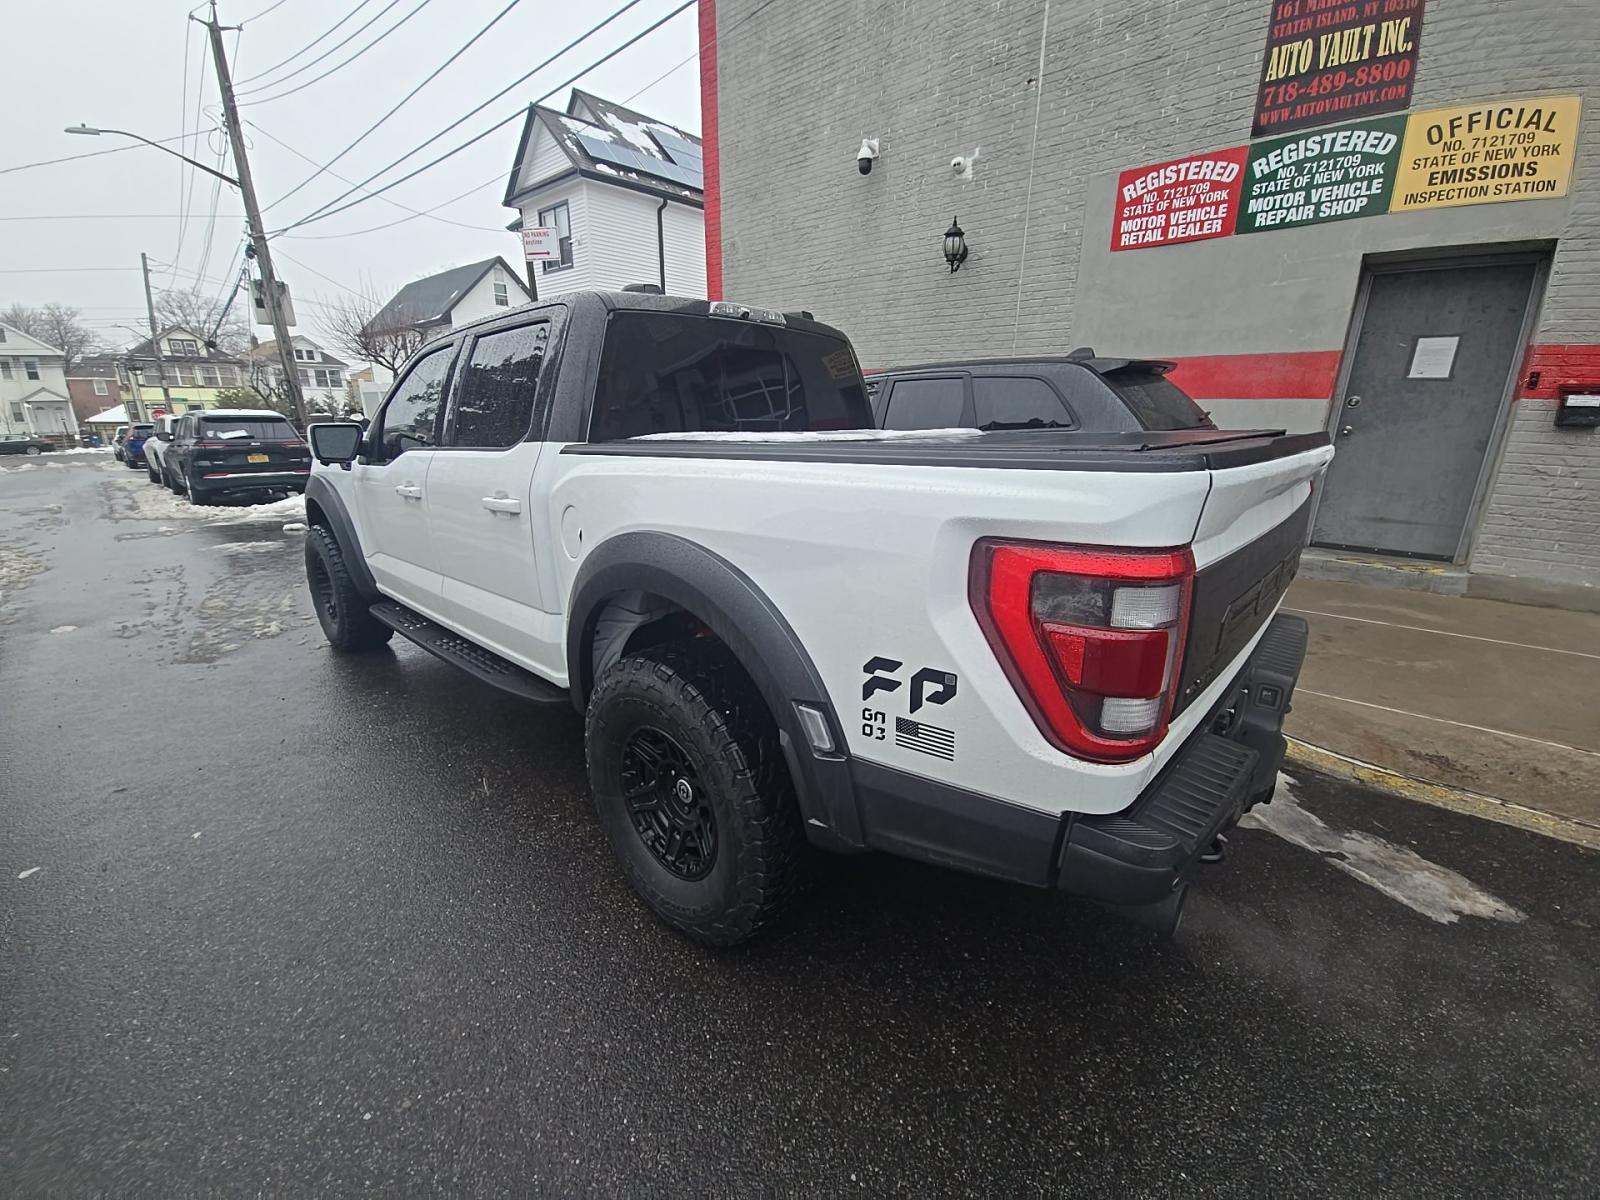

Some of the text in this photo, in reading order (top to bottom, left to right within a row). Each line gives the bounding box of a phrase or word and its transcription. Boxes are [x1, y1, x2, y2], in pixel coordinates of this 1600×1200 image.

[1272, 18, 1312, 39] STATEN
[1316, 6, 1359, 27] ISLAND,
[1363, 2, 1380, 17] NY
[1276, 0, 1299, 20] 161
[1266, 17, 1413, 81] AUTO VAULT INC.
[1264, 58, 1412, 107] 718-489-8800
[1260, 85, 1408, 126] WWW.AUTOVAULTNY.COM
[1427, 107, 1557, 146] OFFICIAL
[1252, 130, 1397, 179] REGISTERED
[1412, 143, 1561, 171] STATE OF NEW YORK
[1442, 132, 1536, 153] NO. 7121709
[1123, 160, 1239, 202] REGISTERED
[1252, 162, 1386, 196] STATE OF NEW YORK
[1277, 154, 1362, 180] NO. 7121709
[1427, 161, 1538, 187] EMISSIONS
[1123, 189, 1229, 218] STATE OF NEW YORK
[1142, 182, 1210, 204] NO. 7121709
[1248, 178, 1384, 213] MOTOR VEHICLE
[1404, 180, 1557, 206] INSPECTION STATION
[1121, 204, 1228, 233] MOTOR VEHICLE
[1255, 197, 1368, 227] REPAIR SHOP
[1120, 219, 1222, 246] RETAIL DEALER
[862, 723, 886, 741] 03
